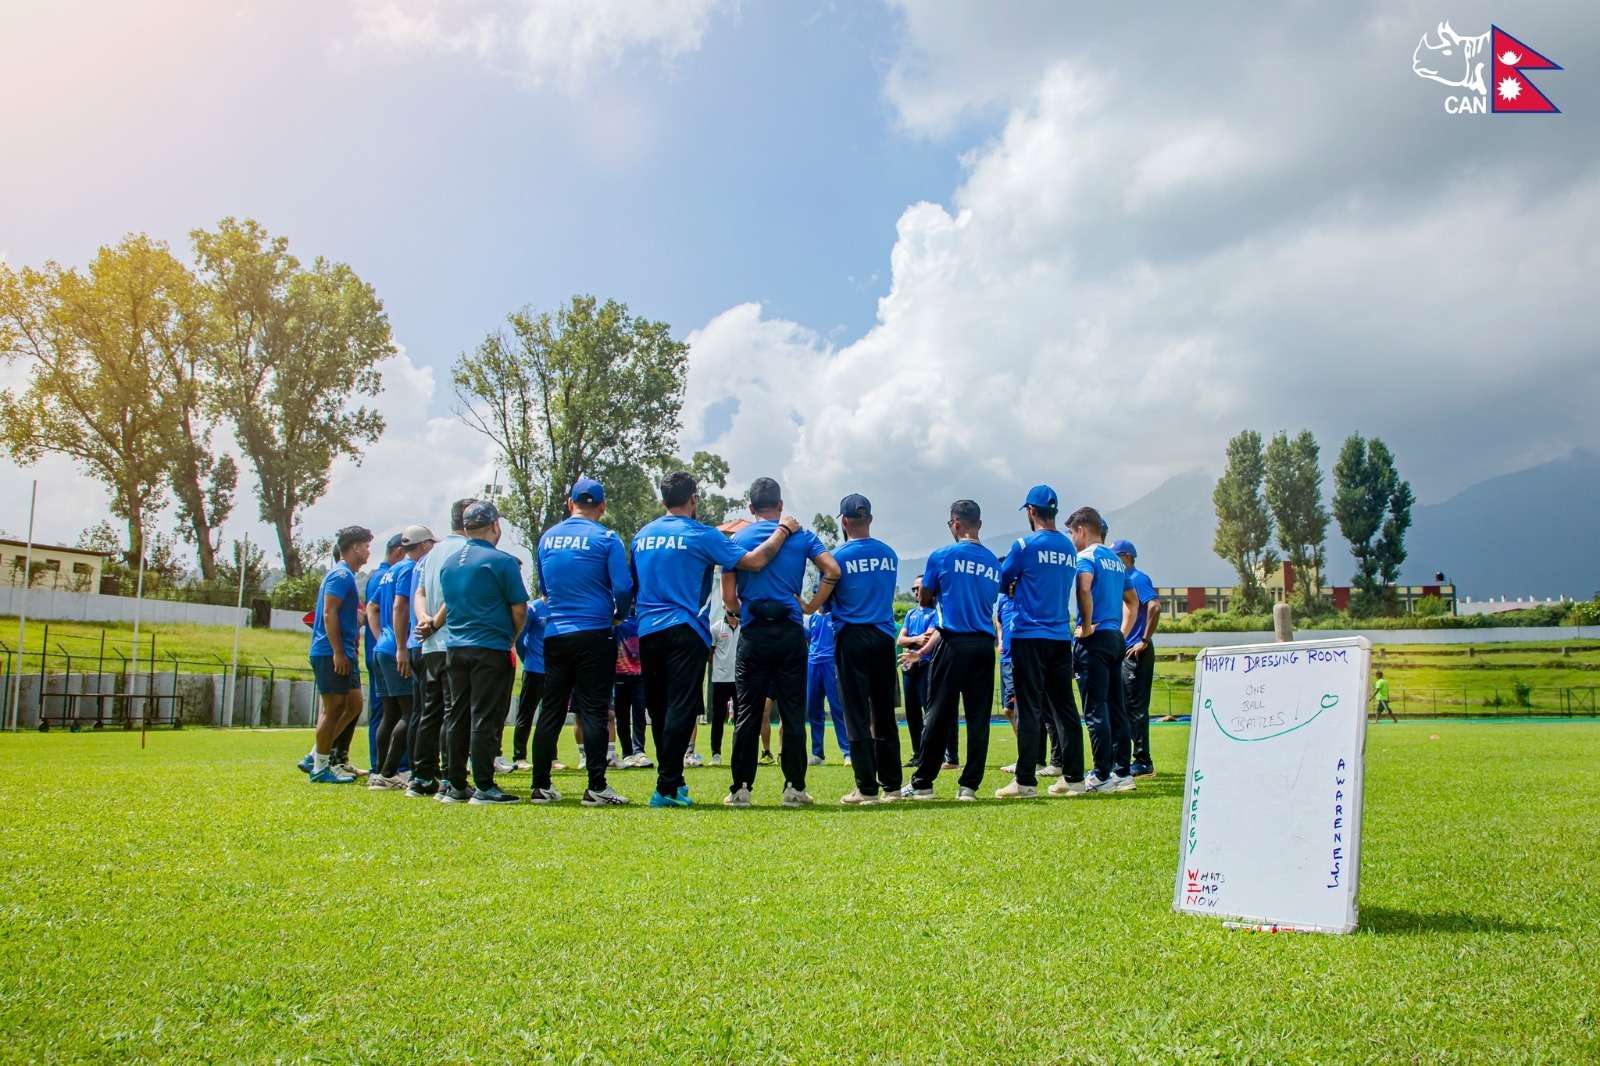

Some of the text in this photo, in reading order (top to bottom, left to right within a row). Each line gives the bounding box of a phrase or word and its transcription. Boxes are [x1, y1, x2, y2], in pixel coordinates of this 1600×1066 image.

[543, 536, 591, 550] NEPAL
[636, 535, 688, 553] NEPAL
[845, 558, 897, 574] NEPAL
[1038, 550, 1077, 569] NEPAL
[954, 559, 1001, 583] NEPAL
[1205, 649, 1349, 673] HAPPY DRESSING ROOM
[1244, 684, 1265, 696] ONE
[1241, 700, 1265, 712] BALL
[1189, 769, 1204, 854] ENERGY
[1327, 758, 1345, 888] AWARENESS
[1187, 883, 1218, 894] IMP
[1186, 895, 1219, 907] NOW
